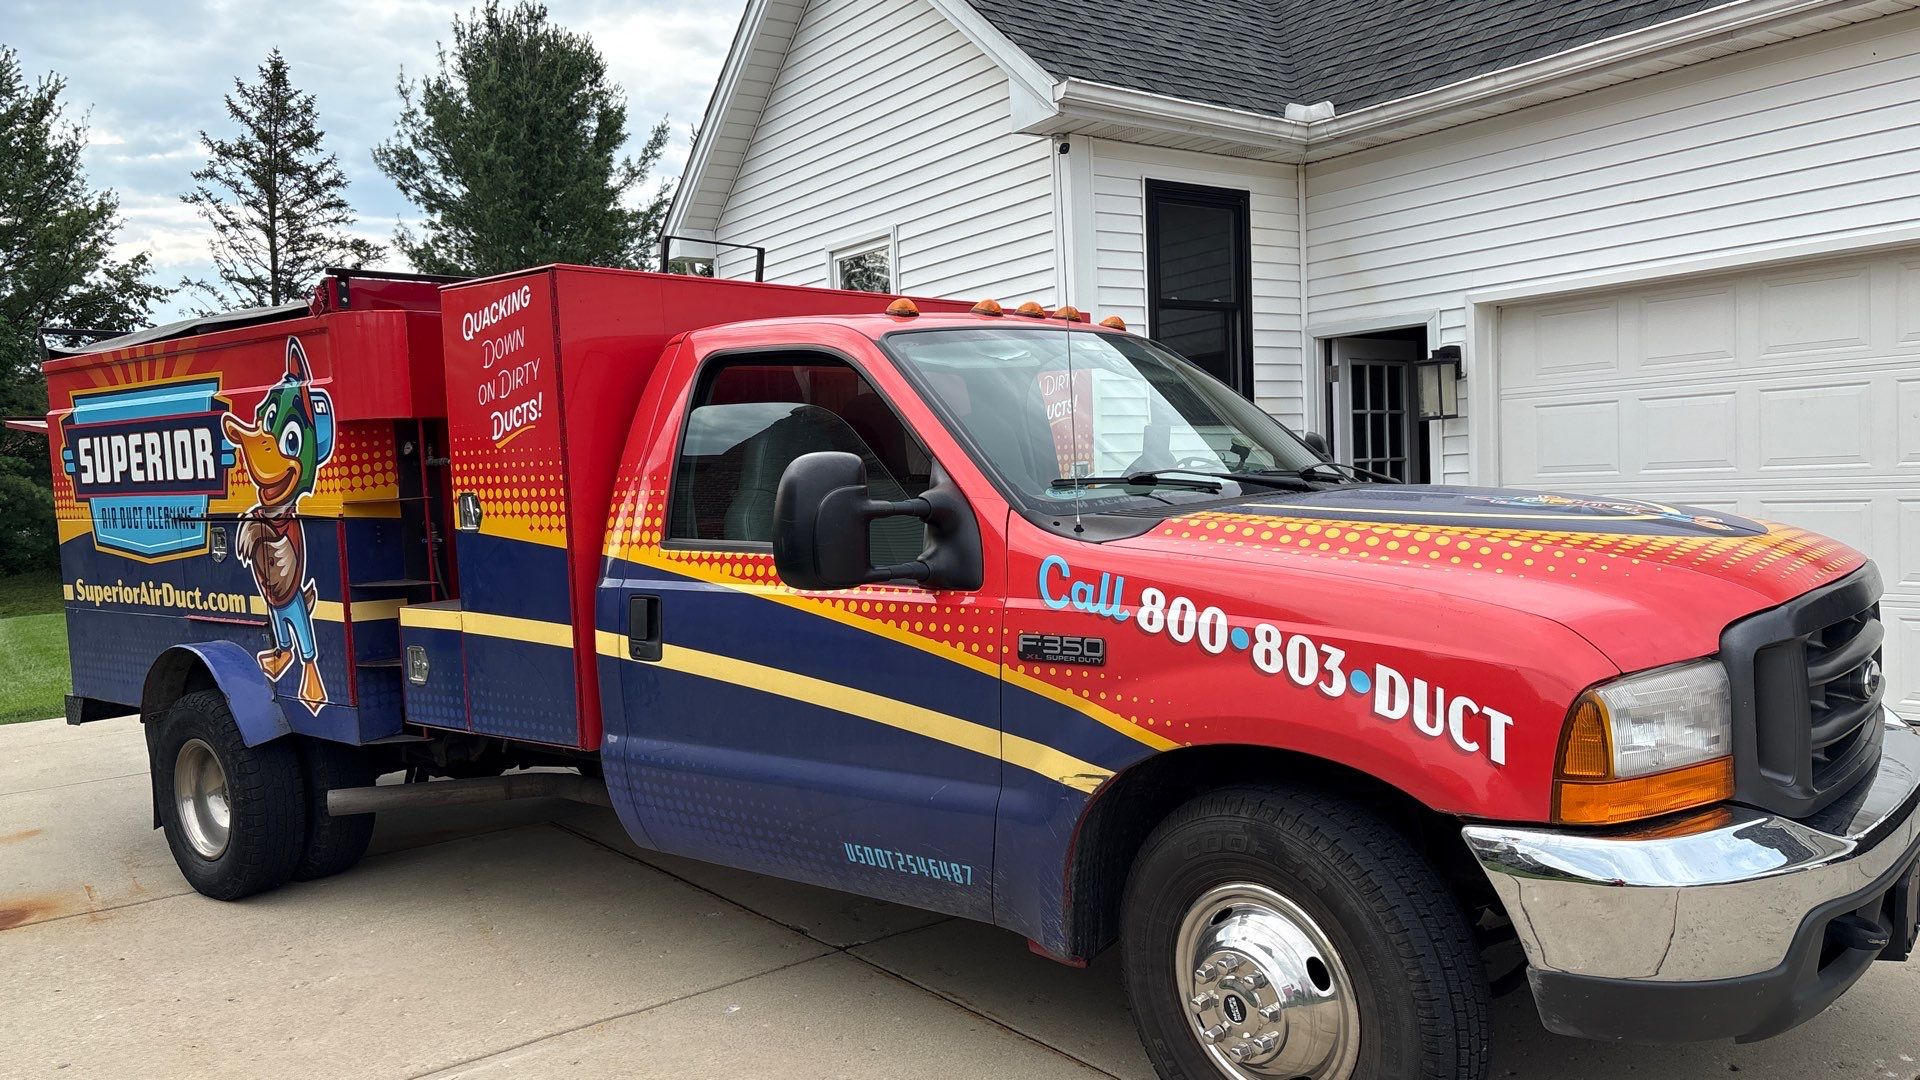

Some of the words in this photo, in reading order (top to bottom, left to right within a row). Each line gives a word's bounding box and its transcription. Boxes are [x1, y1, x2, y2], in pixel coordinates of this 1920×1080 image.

[462, 284, 531, 341] QUACKING
[482, 326, 525, 369] DOWN
[498, 358, 541, 399] DIRTY
[1044, 372, 1077, 396] DIRTY
[490, 391, 543, 441] DUCTS!
[1047, 395, 1078, 420] UCTS!
[78, 428, 216, 484] SUPERIOR
[101, 506, 117, 530] AIR
[120, 505, 143, 530] DUCT
[146, 505, 196, 530] CLEANING
[75, 578, 247, 614] SuperiorAirDuct.com
[1038, 554, 1130, 622] Call
[1046, 654, 1076, 662] SUPER
[1078, 656, 1103, 664] DUTY
